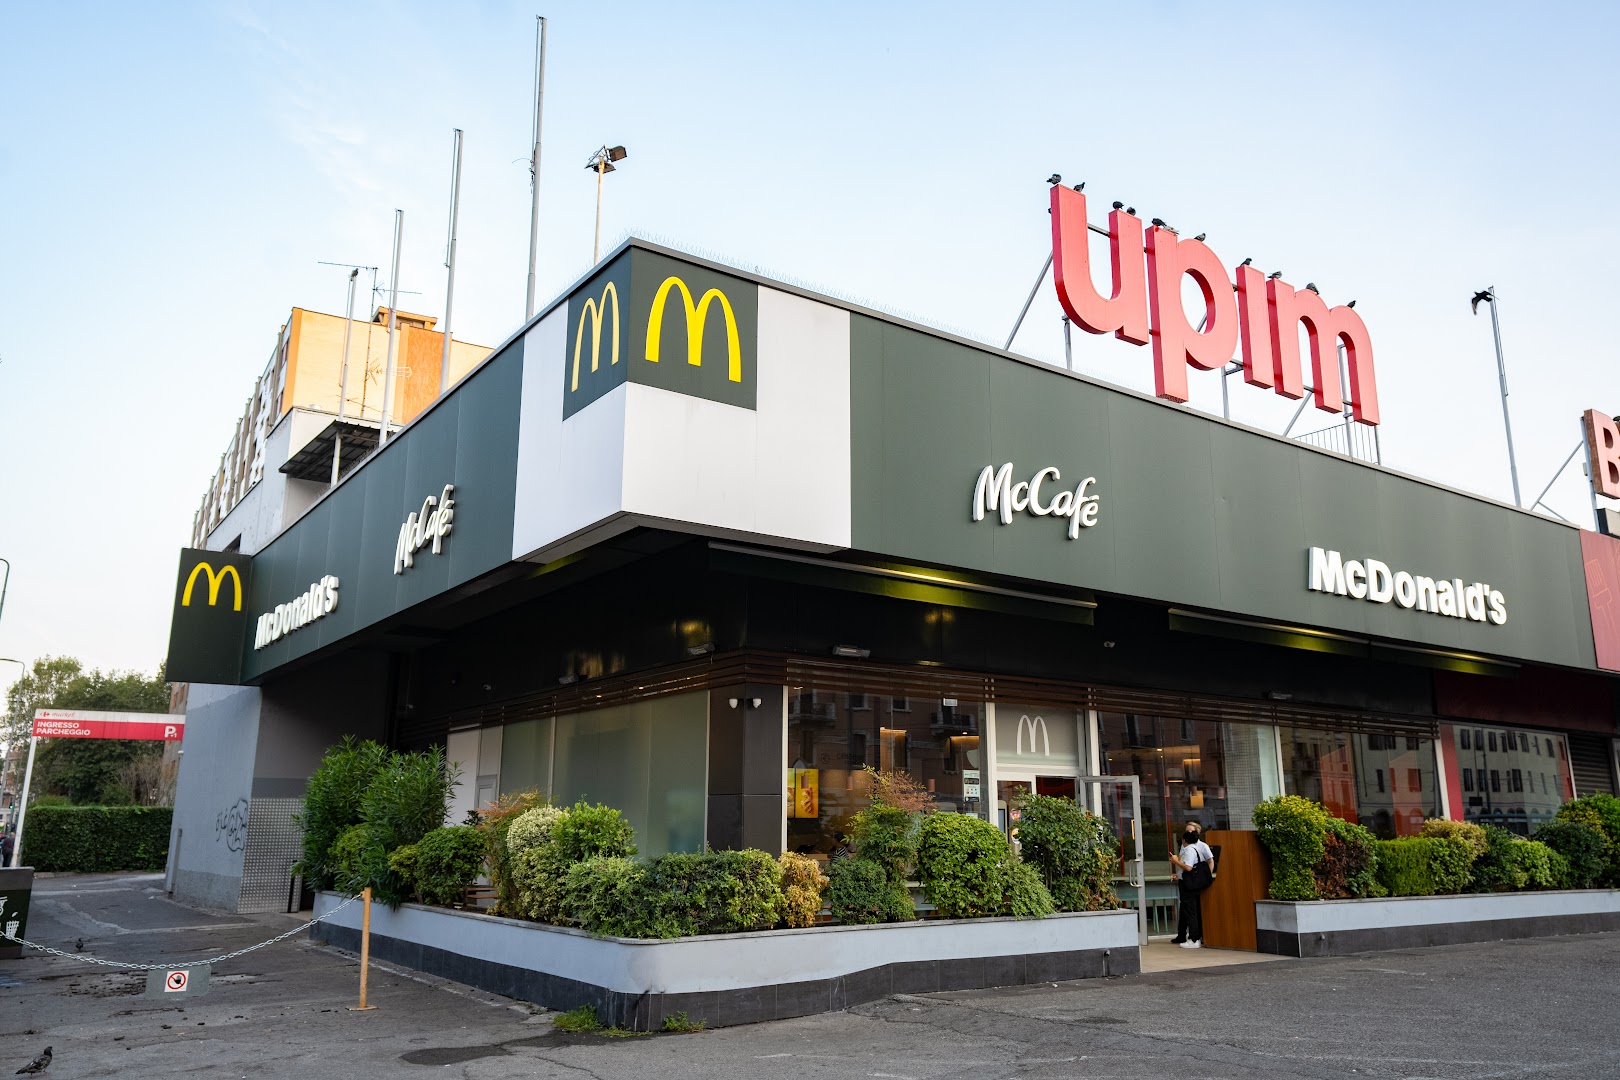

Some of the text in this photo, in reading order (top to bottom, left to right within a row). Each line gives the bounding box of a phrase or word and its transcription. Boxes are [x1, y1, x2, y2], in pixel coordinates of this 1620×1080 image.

[1050, 184, 1380, 427] upim
[1584, 408, 1620, 500] B
[393, 484, 455, 575] McCafé
[973, 462, 1100, 540] McCafé
[254, 574, 339, 650] McDonald's
[1308, 546, 1507, 625] McDonald's
[36, 728, 91, 736] PARCHEGGIO
[37, 721, 80, 729] INGRESSO
